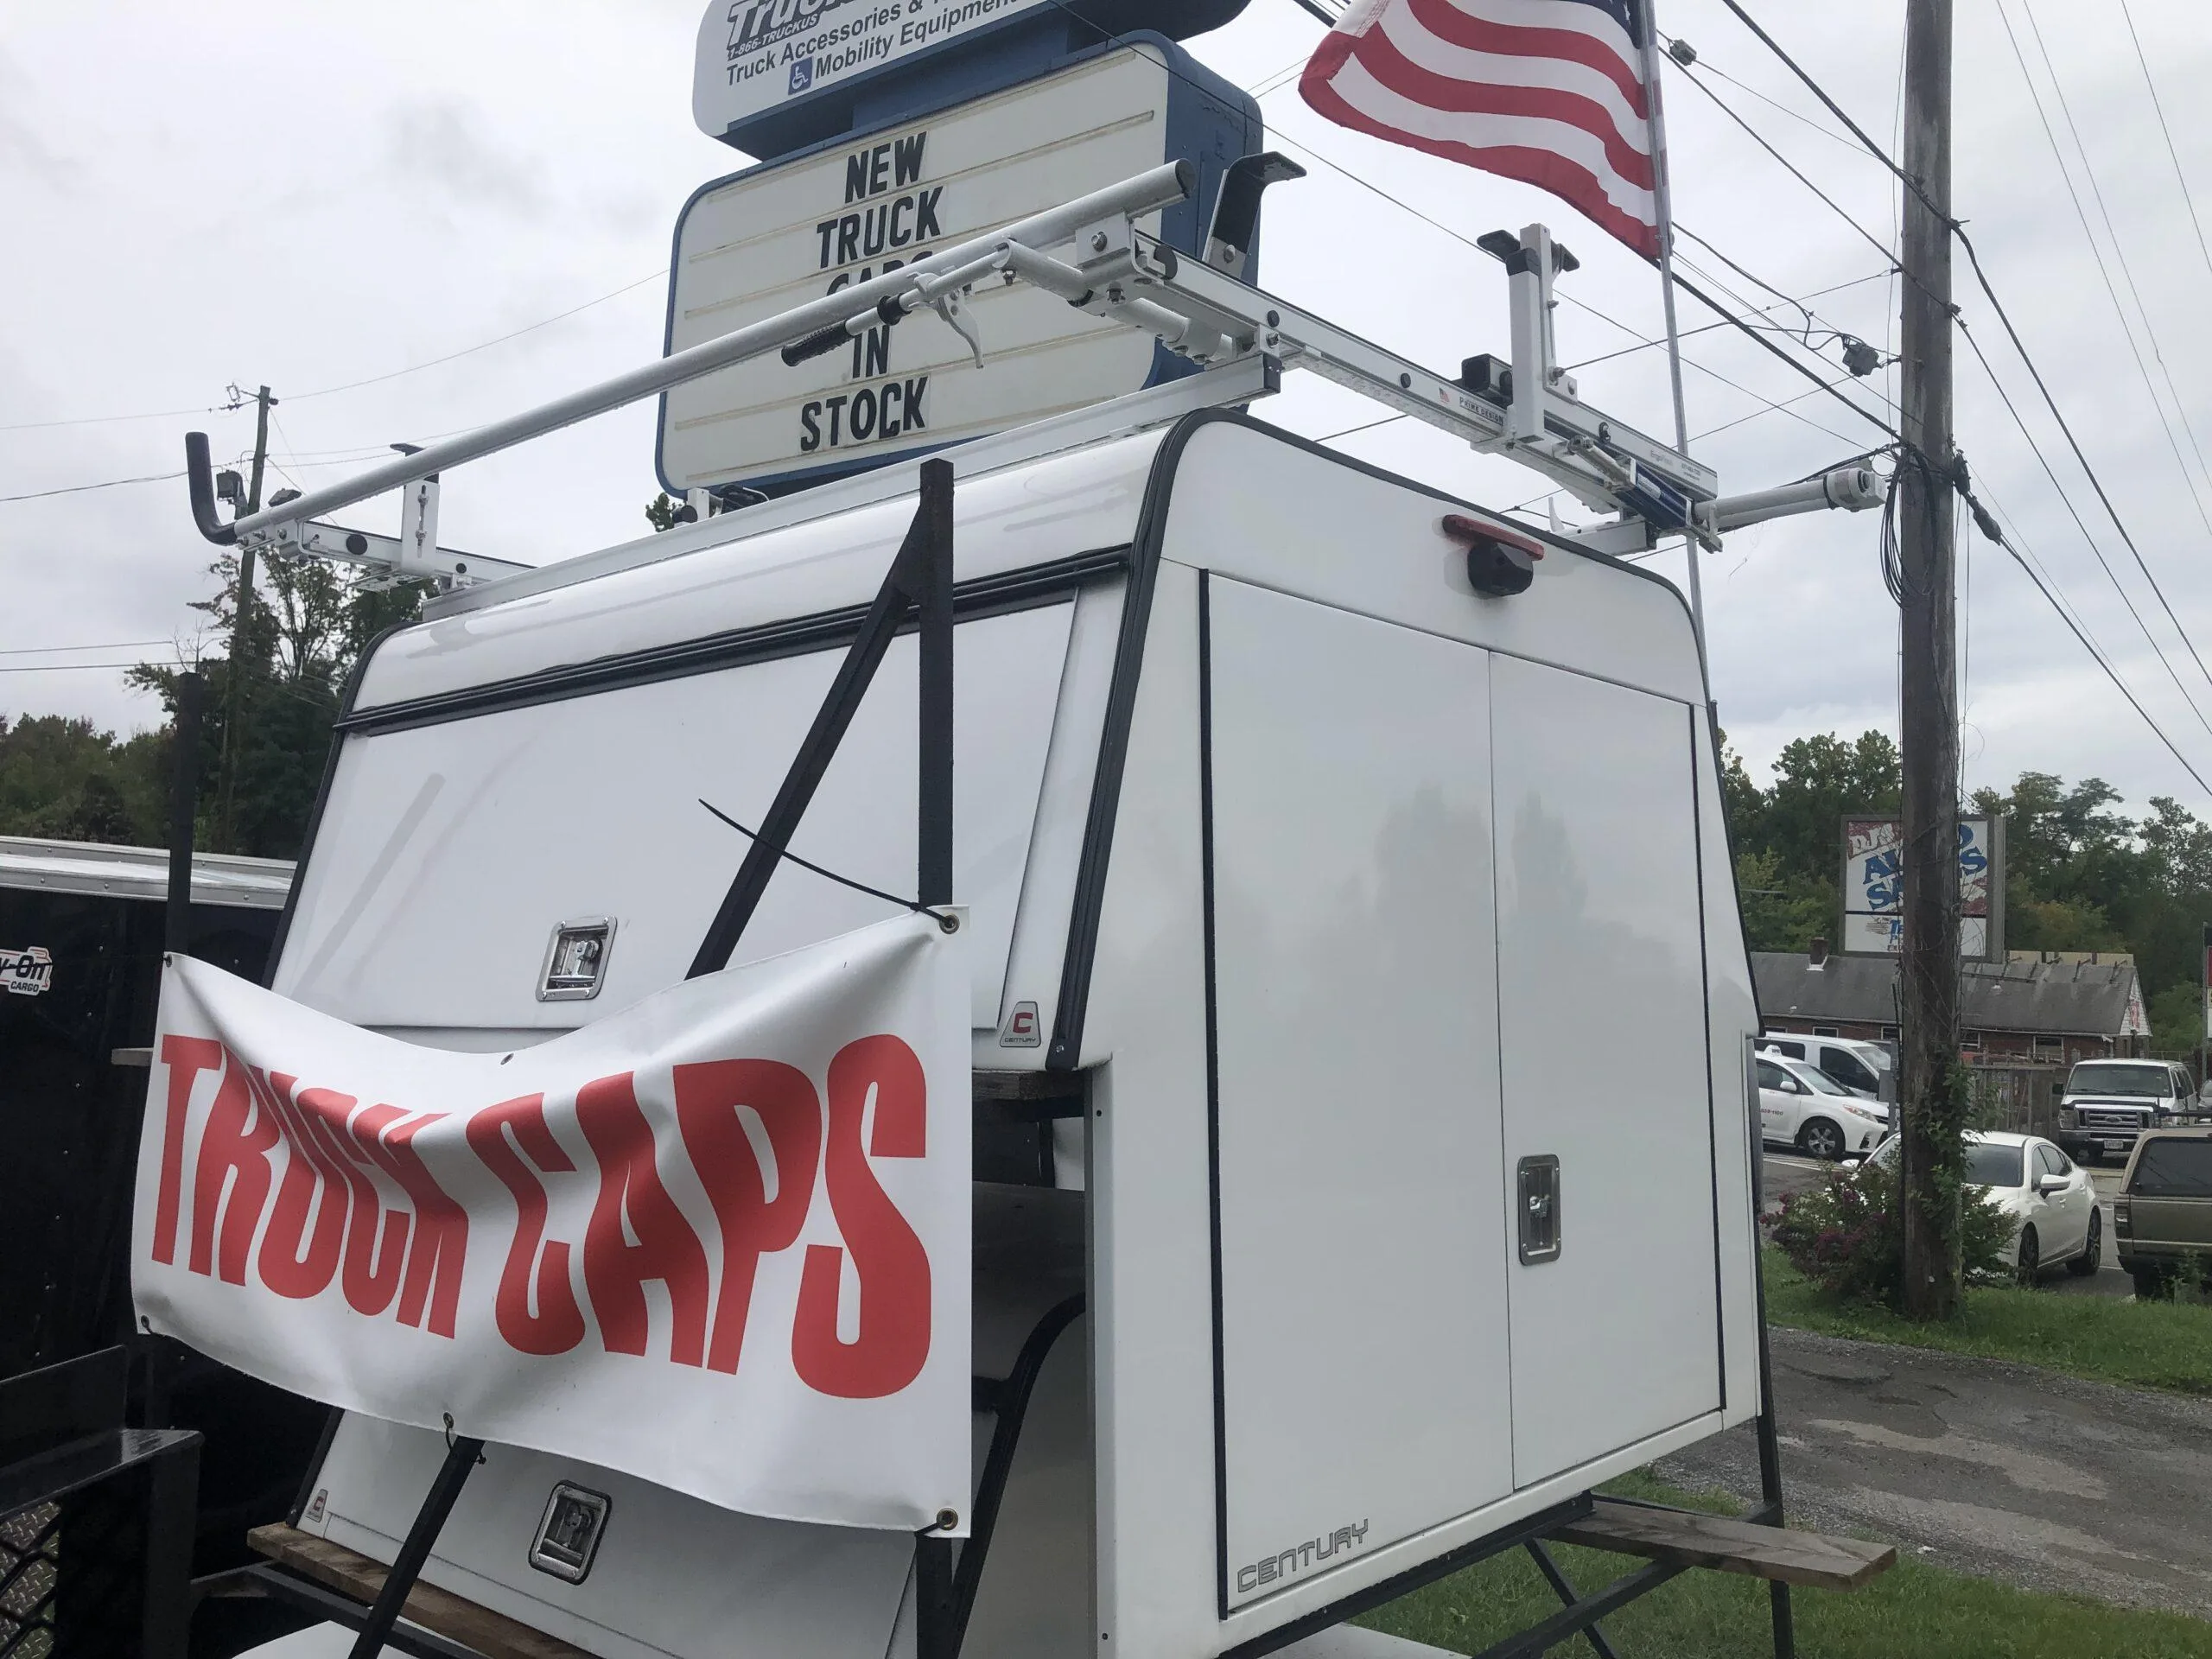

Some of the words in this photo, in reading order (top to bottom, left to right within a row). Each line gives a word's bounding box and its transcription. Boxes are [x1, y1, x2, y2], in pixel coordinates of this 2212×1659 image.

[727, 51, 776, 86] Truck
[780, 7, 900, 66] Accessories
[728, 13, 819, 58] 1-866-TRUCKUS
[815, 35, 894, 79] Mobility
[899, 0, 1016, 46] Equipmen
[845, 131, 927, 203] NEW
[817, 186, 944, 269] TRUCK
[852, 325, 890, 378] IN
[801, 376, 928, 451] STOCK
[10, 981, 40, 993] CARGO
[1013, 1012, 1033, 1033] C
[151, 1034, 468, 1339] TRUCK
[466, 1034, 931, 1399] CAPS
[1237, 1518, 1369, 1592] CENTURY
